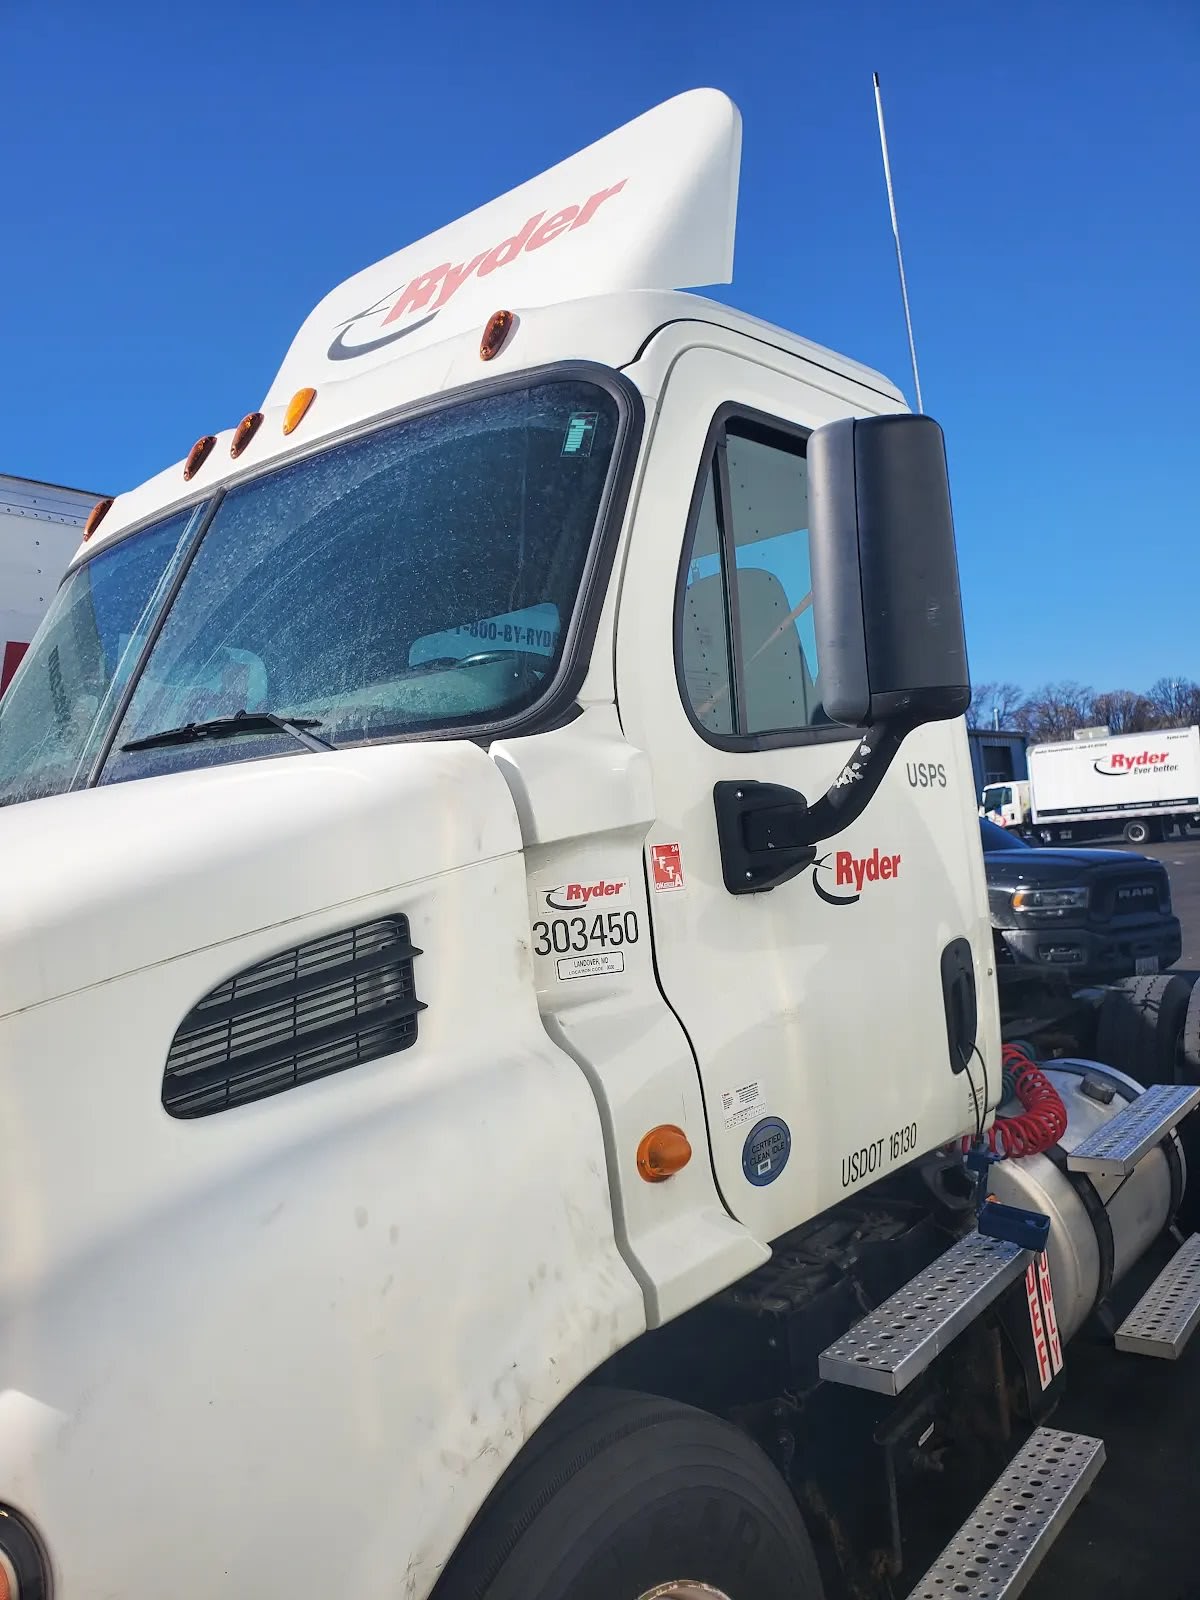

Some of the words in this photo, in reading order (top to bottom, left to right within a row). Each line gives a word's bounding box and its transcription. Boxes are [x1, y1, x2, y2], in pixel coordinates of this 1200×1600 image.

[380, 178, 629, 327] Ryder
[1111, 751, 1169, 769] Ryder
[1133, 766, 1151, 775] Ever
[906, 762, 947, 788] USPS
[836, 848, 901, 891] Ryder
[566, 881, 624, 902] Ryder
[532, 911, 639, 956] 303450
[750, 1148, 770, 1167] CLEAN
[771, 1141, 785, 1155] IDLE
[751, 1132, 782, 1154] CERTIFIED
[841, 1138, 885, 1187] USDOT
[889, 1122, 917, 1162] 16130
